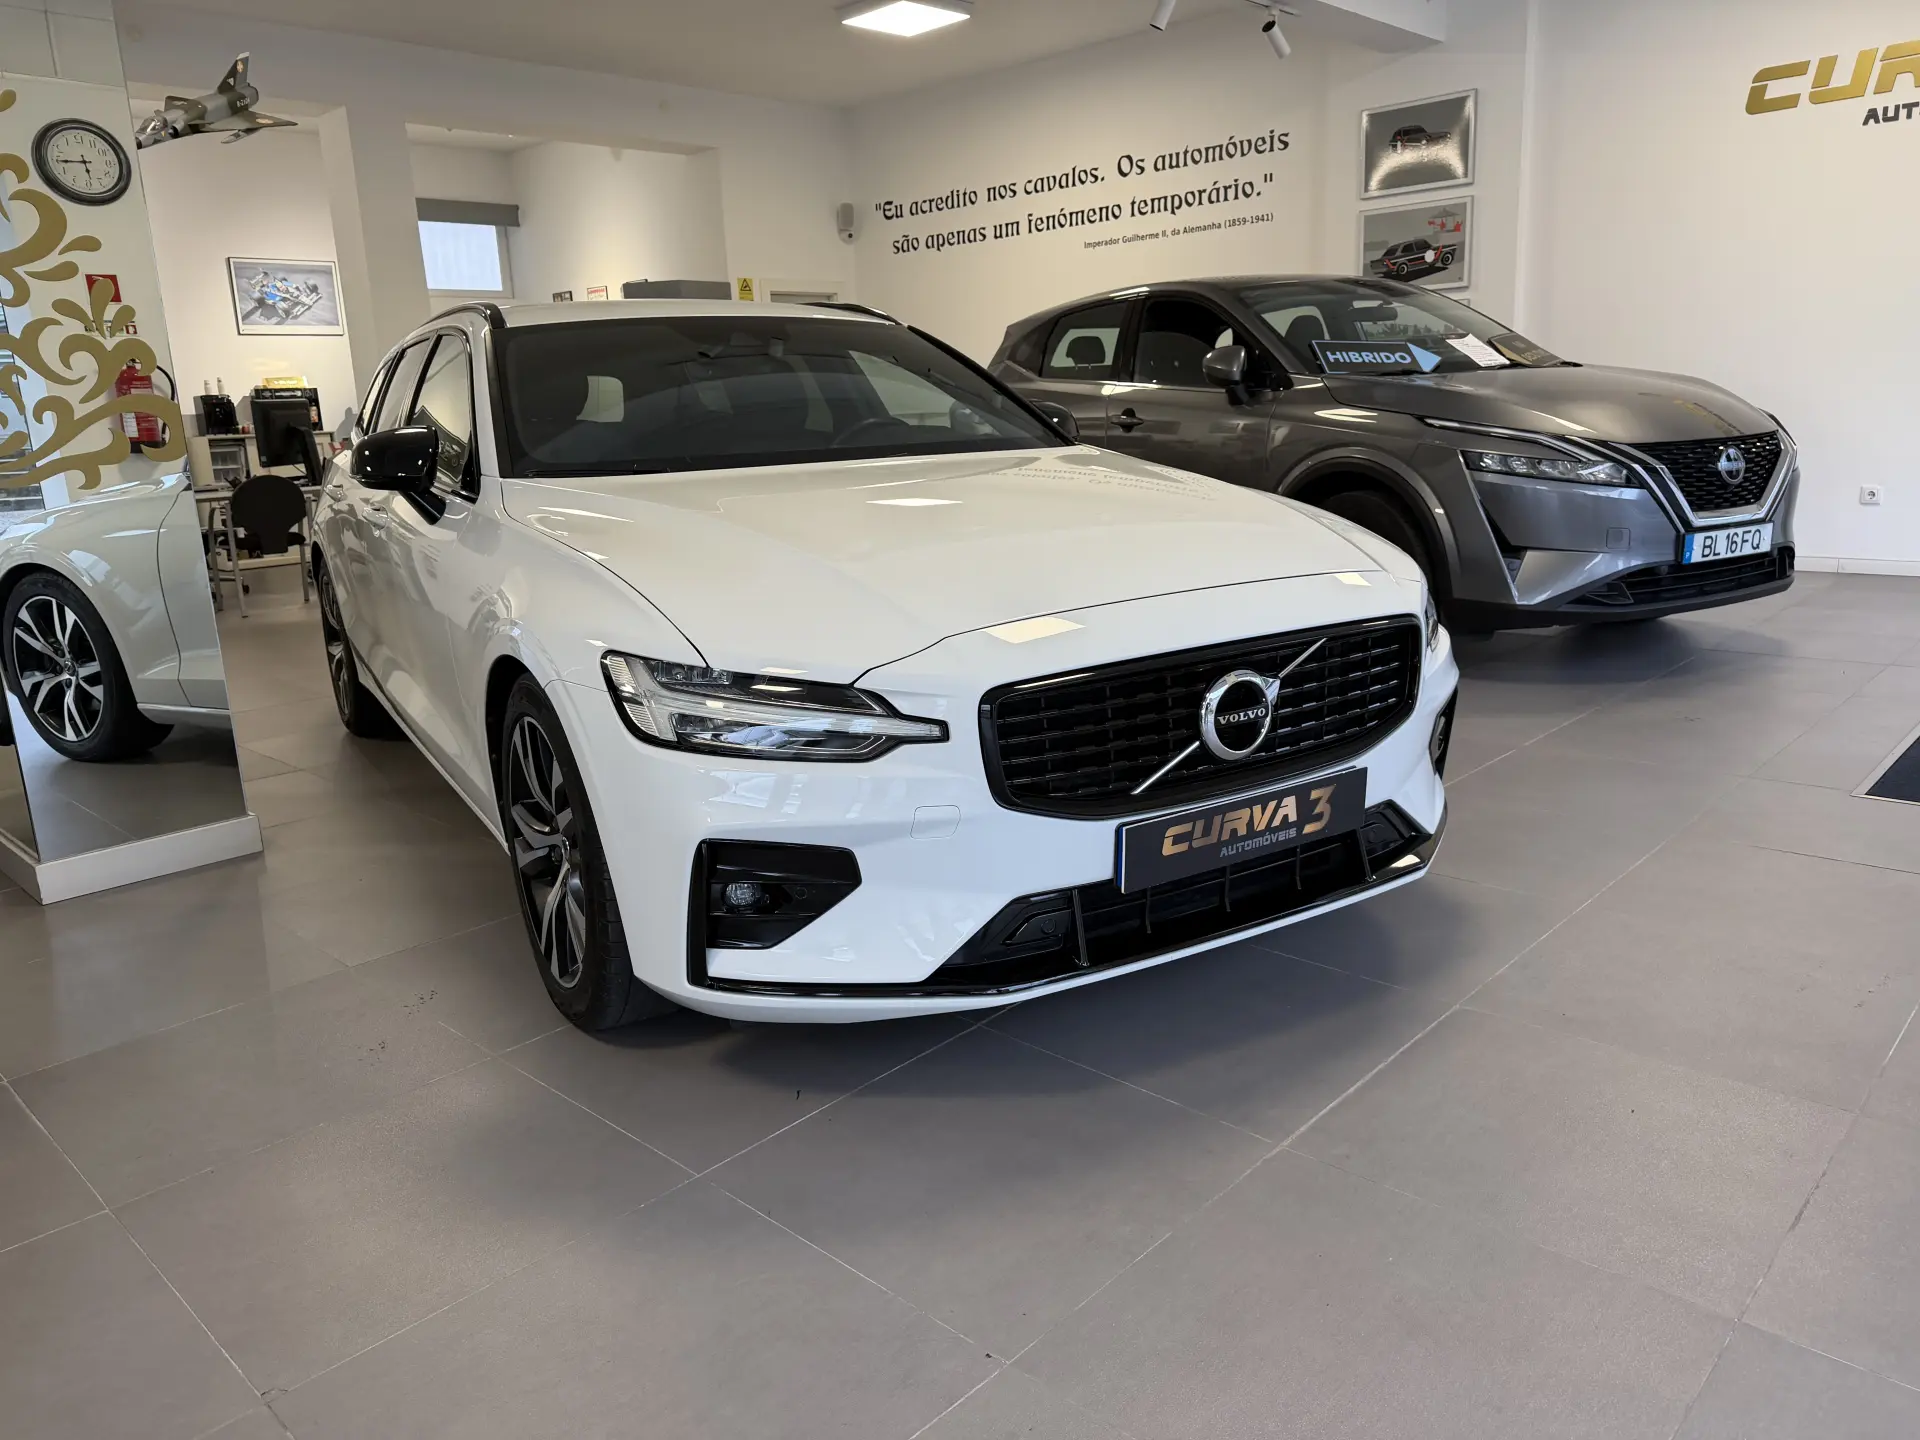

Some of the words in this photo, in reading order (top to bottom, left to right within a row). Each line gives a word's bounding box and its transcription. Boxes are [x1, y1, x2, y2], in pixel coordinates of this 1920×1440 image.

[1861, 101, 1920, 126] AUT
[875, 200, 904, 221] "Eu
[909, 187, 978, 216] acredito
[986, 182, 1018, 203] nos
[1023, 165, 1105, 195] cavalos.
[1117, 154, 1146, 178] Os
[1153, 129, 1290, 172] automóveis
[892, 234, 920, 255] são
[925, 226, 987, 252] apenas
[993, 220, 1021, 240] um
[1027, 203, 1122, 234] fenómeno
[1130, 172, 1274, 217] temporário."
[1084, 237, 1120, 250] Imperador
[1121, 231, 1160, 244] Guilherme
[1170, 226, 1181, 237] da
[1182, 222, 1222, 235] Alemanha
[1223, 212, 1274, 229] (1859-1941)
[1325, 350, 1412, 365] HIBRIDO
[1217, 707, 1266, 725] VOLVO
[1162, 795, 1298, 857] CURVA
[1302, 783, 1337, 835] 3
[1219, 827, 1297, 858] AUTOMÓVEIS
